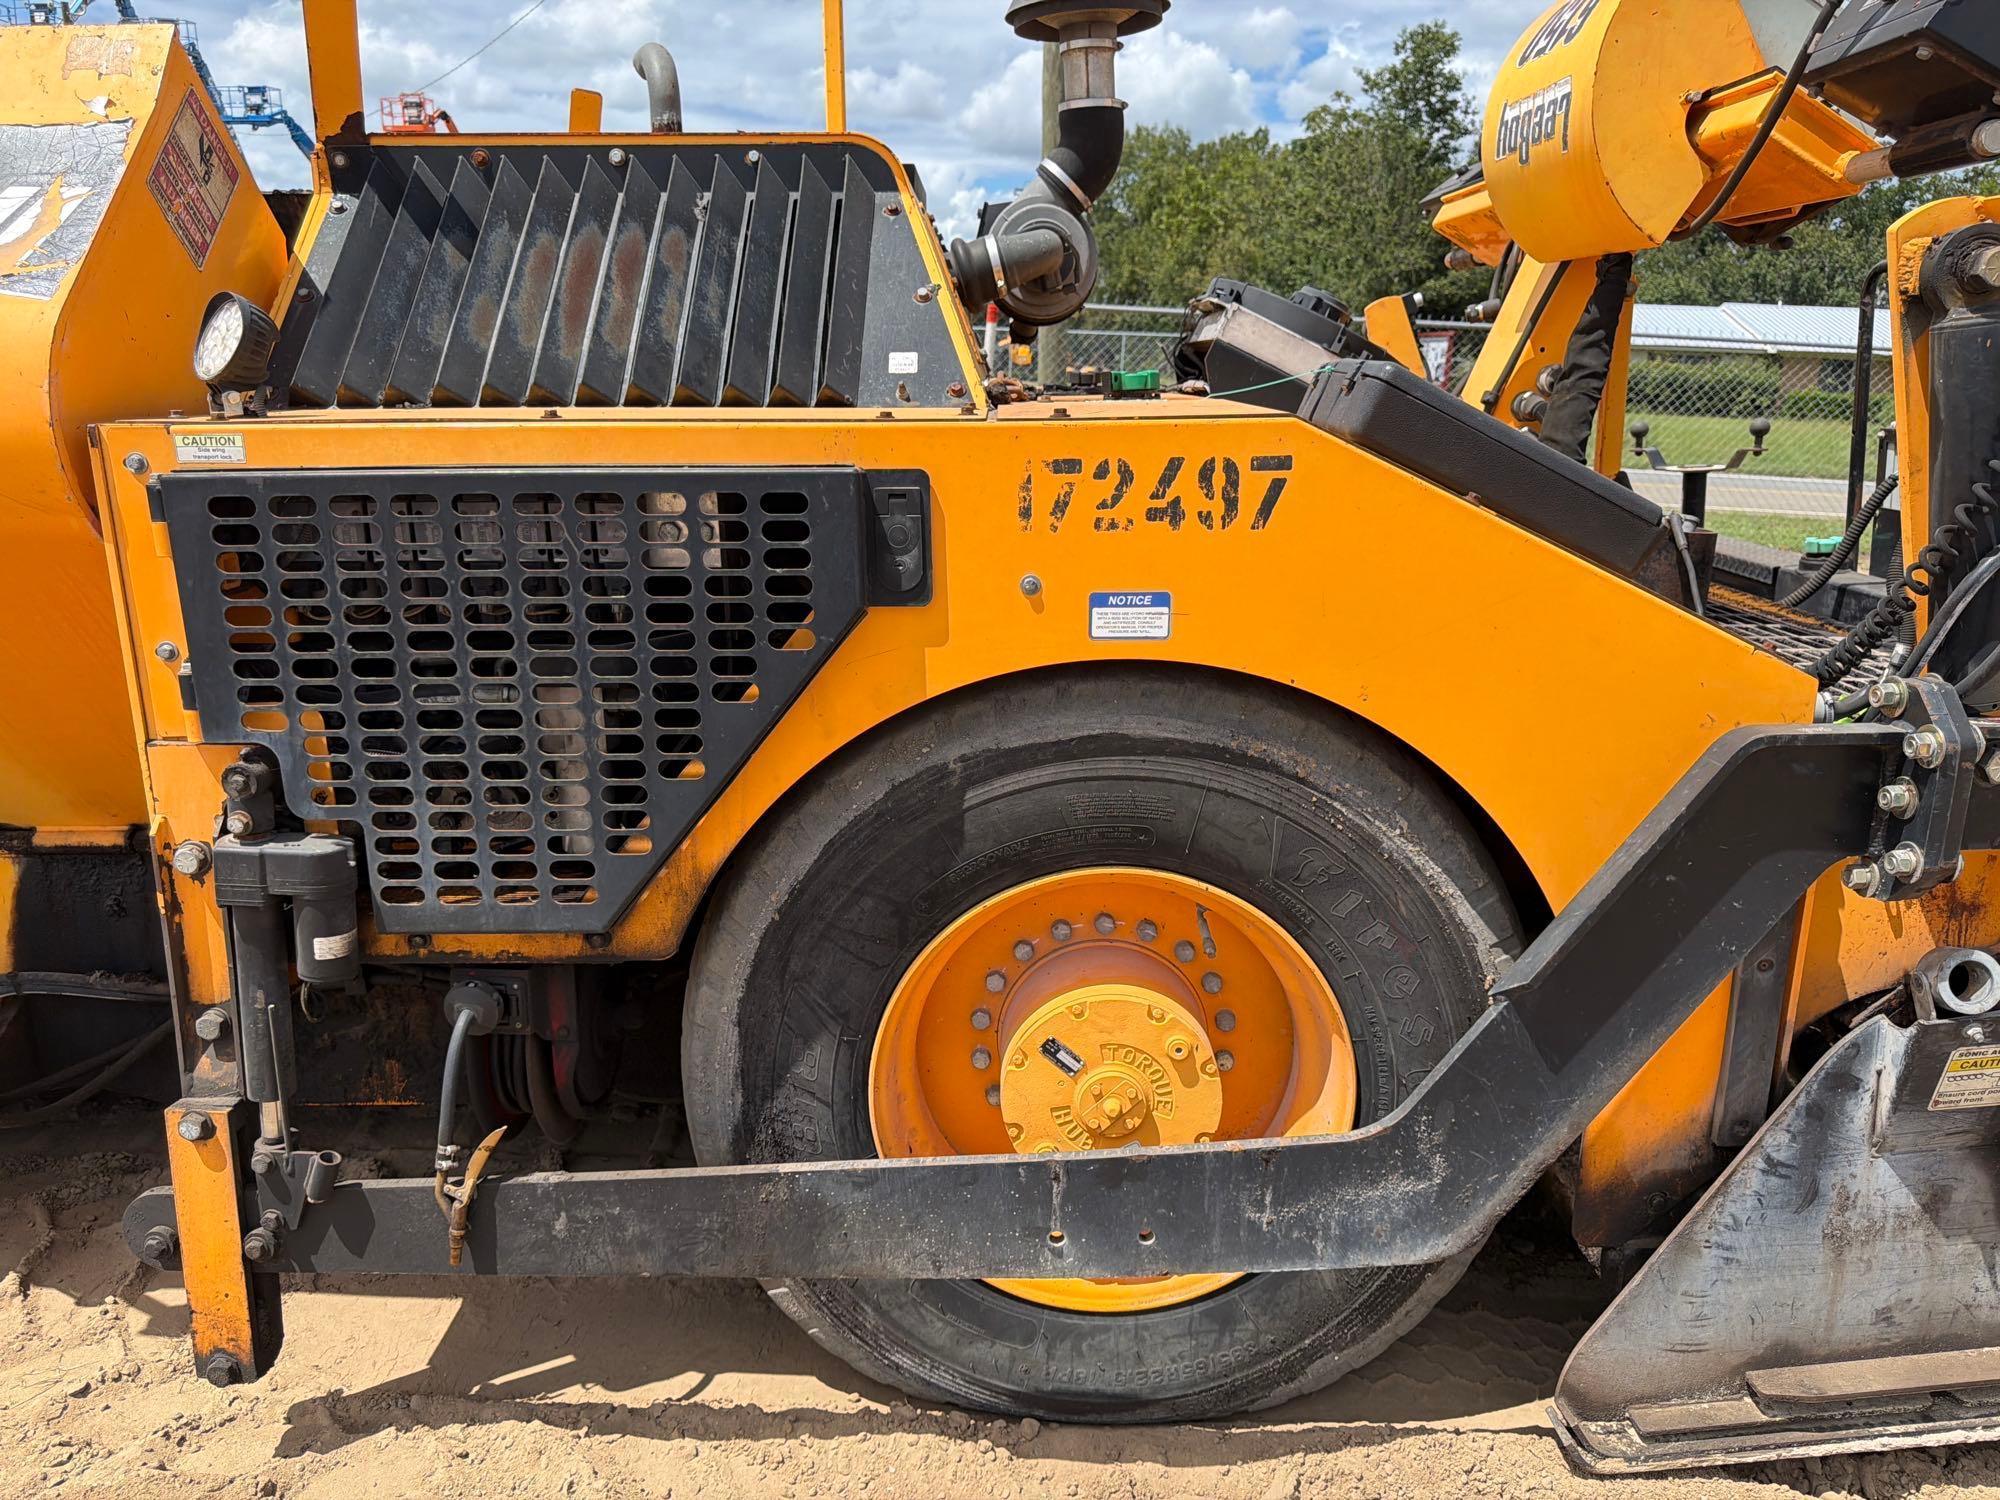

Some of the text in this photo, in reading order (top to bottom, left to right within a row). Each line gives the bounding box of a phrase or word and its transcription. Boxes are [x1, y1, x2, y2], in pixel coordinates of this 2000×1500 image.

[182, 436, 236, 446] CAUTION
[1018, 455, 1293, 533] 172497
[1108, 596, 1152, 605] NOTICE
[1106, 1045, 1174, 1113] TORQUE
[1052, 1108, 1094, 1150] HUB
